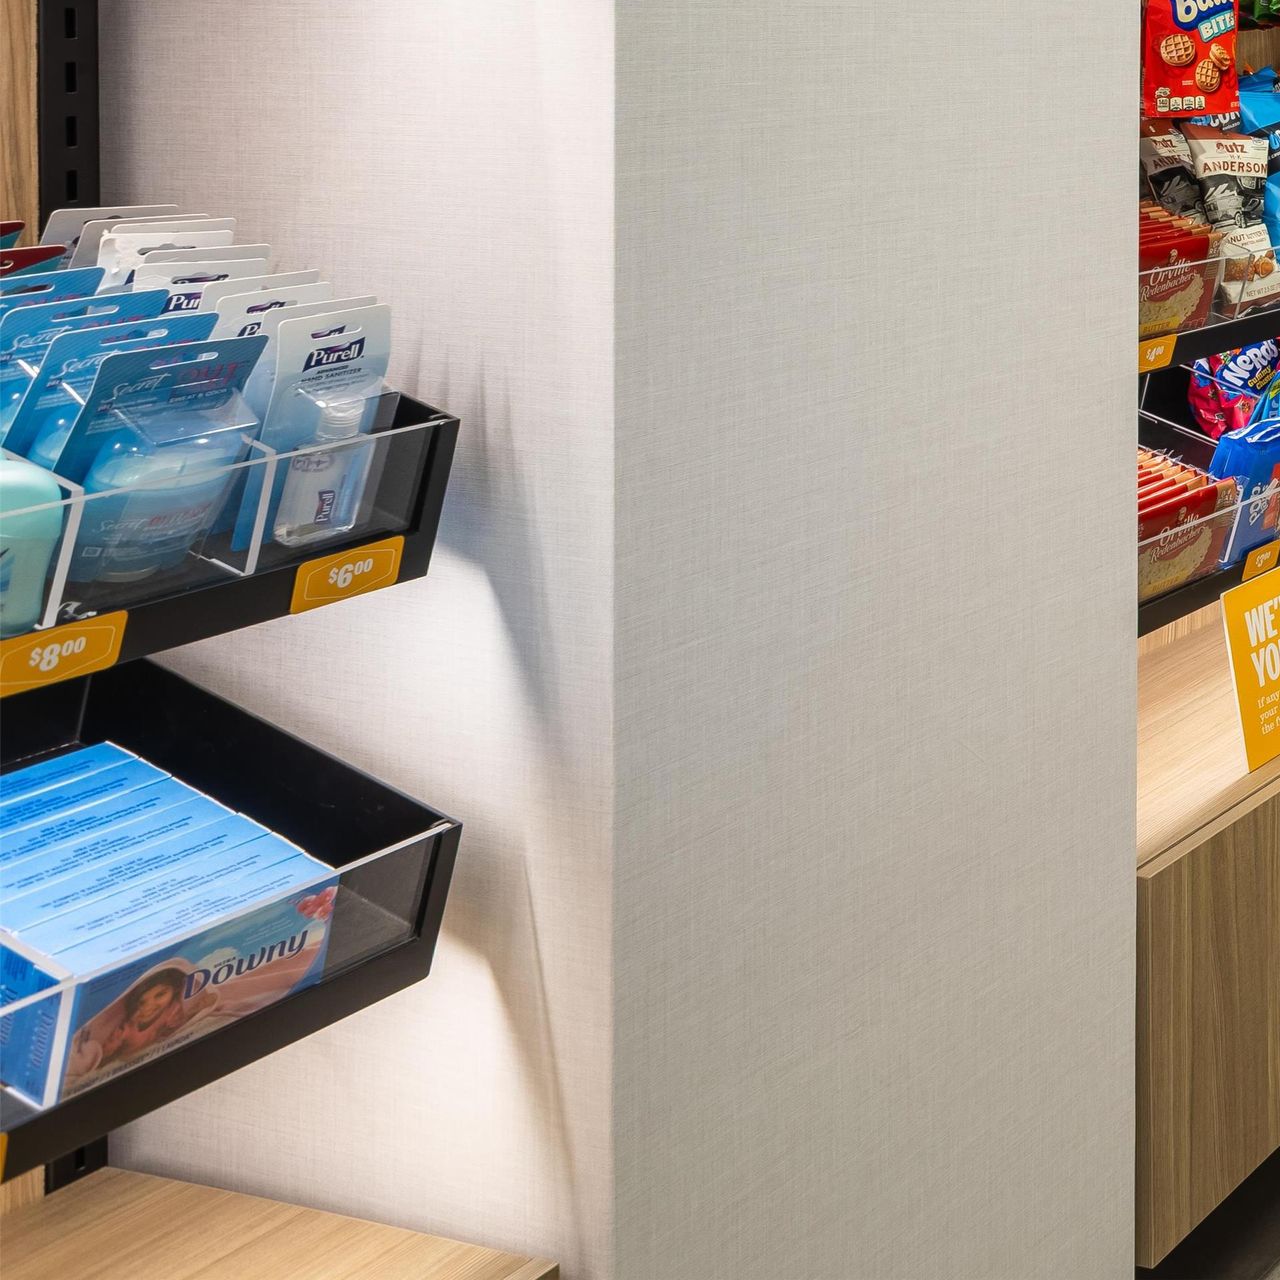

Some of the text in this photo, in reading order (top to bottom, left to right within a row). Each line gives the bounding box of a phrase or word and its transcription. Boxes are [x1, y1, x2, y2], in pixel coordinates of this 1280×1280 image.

[310, 343, 361, 365] Purell
[324, 368, 362, 380] SANITIZER
[1257, 697, 1266, 709] If
[1266, 692, 1280, 707] any
[1260, 708, 1278, 724] your
[1262, 723, 1274, 735] the
[183, 929, 309, 999] Downy
